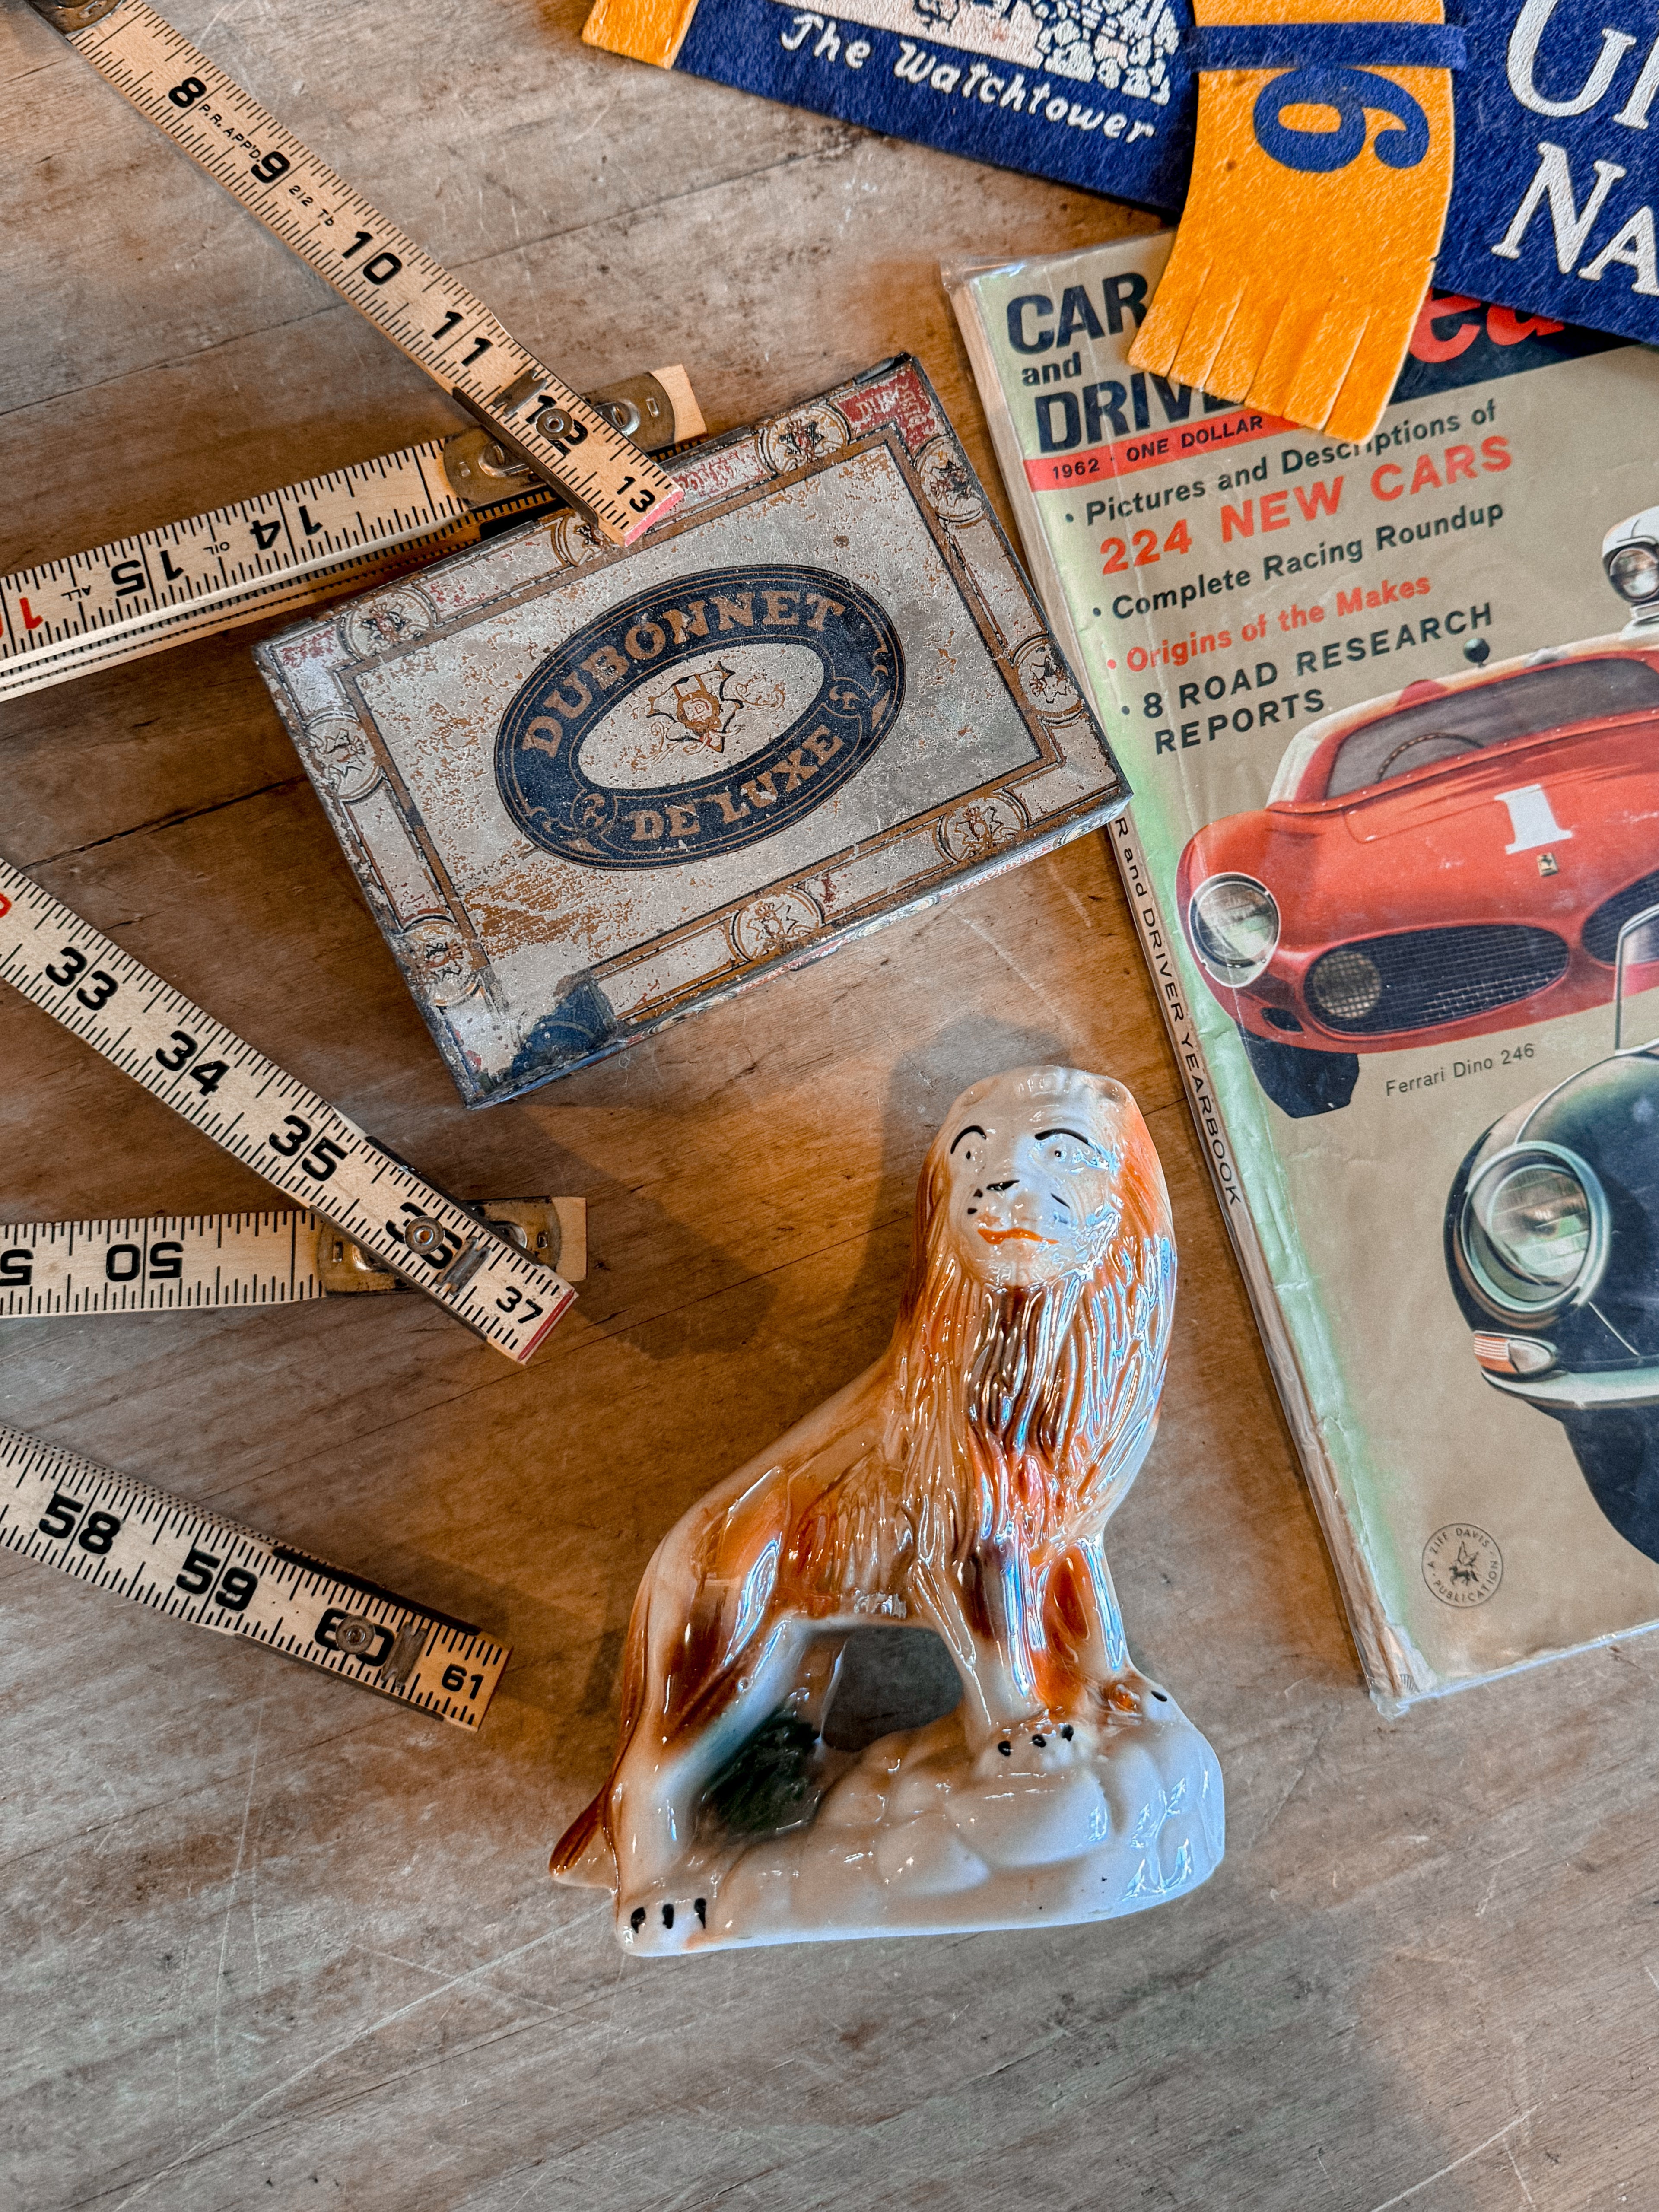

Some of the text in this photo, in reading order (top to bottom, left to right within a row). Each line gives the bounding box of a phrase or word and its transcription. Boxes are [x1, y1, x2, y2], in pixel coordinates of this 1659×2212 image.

[168, 77, 207, 108] 8
[780, 13, 1156, 143] The Watchtower
[199, 103, 223, 127] P.R.
[251, 151, 290, 184] 9
[288, 185, 313, 207] 212
[342, 231, 403, 286] 10
[432, 311, 494, 367] 11
[1007, 271, 1148, 355] CAR
[1022, 351, 1082, 387] and
[1034, 371, 1244, 454] DRIV
[1052, 415, 1263, 480] 1962 ONE DOLLAR
[1086, 477, 1205, 526] Pictures
[1218, 458, 1268, 491] and
[1471, 399, 1496, 426] of
[616, 475, 656, 513] 13
[1100, 435, 1512, 575] 224 NEW CARS
[250, 506, 323, 550] 14
[111, 550, 184, 597] 15
[1112, 503, 1503, 620] Complete Racing Roundup
[0, 597, 43, 638] 1
[1126, 575, 1431, 672] Origins of the Makes
[521, 590, 846, 759] DUBONNET
[1142, 603, 1492, 719] 8 ROAD RESEARCH
[1155, 689, 1325, 755] REPORTS
[631, 725, 845, 841] DE LUXE
[1494, 784, 1573, 855] 1
[45, 946, 119, 1011] 33
[1124, 848, 1147, 897] and
[1142, 908, 1184, 1022] DRIVER
[1181, 1032, 1241, 1205] YEARBOOK
[156, 1030, 230, 1096] 34
[1386, 1042, 1535, 1096] Ferrari Dino 246
[268, 1114, 347, 1182] 35
[106, 1241, 184, 1282] 50
[496, 1286, 545, 1324] 37
[38, 1491, 121, 1555] 58
[1429, 1531, 1449, 1554] ZIFF
[1456, 1527, 1490, 1548] DAVIS
[175, 1549, 259, 1611] 59
[1433, 1560, 1498, 1602] PUBLICATION
[441, 1664, 485, 1700] 61
